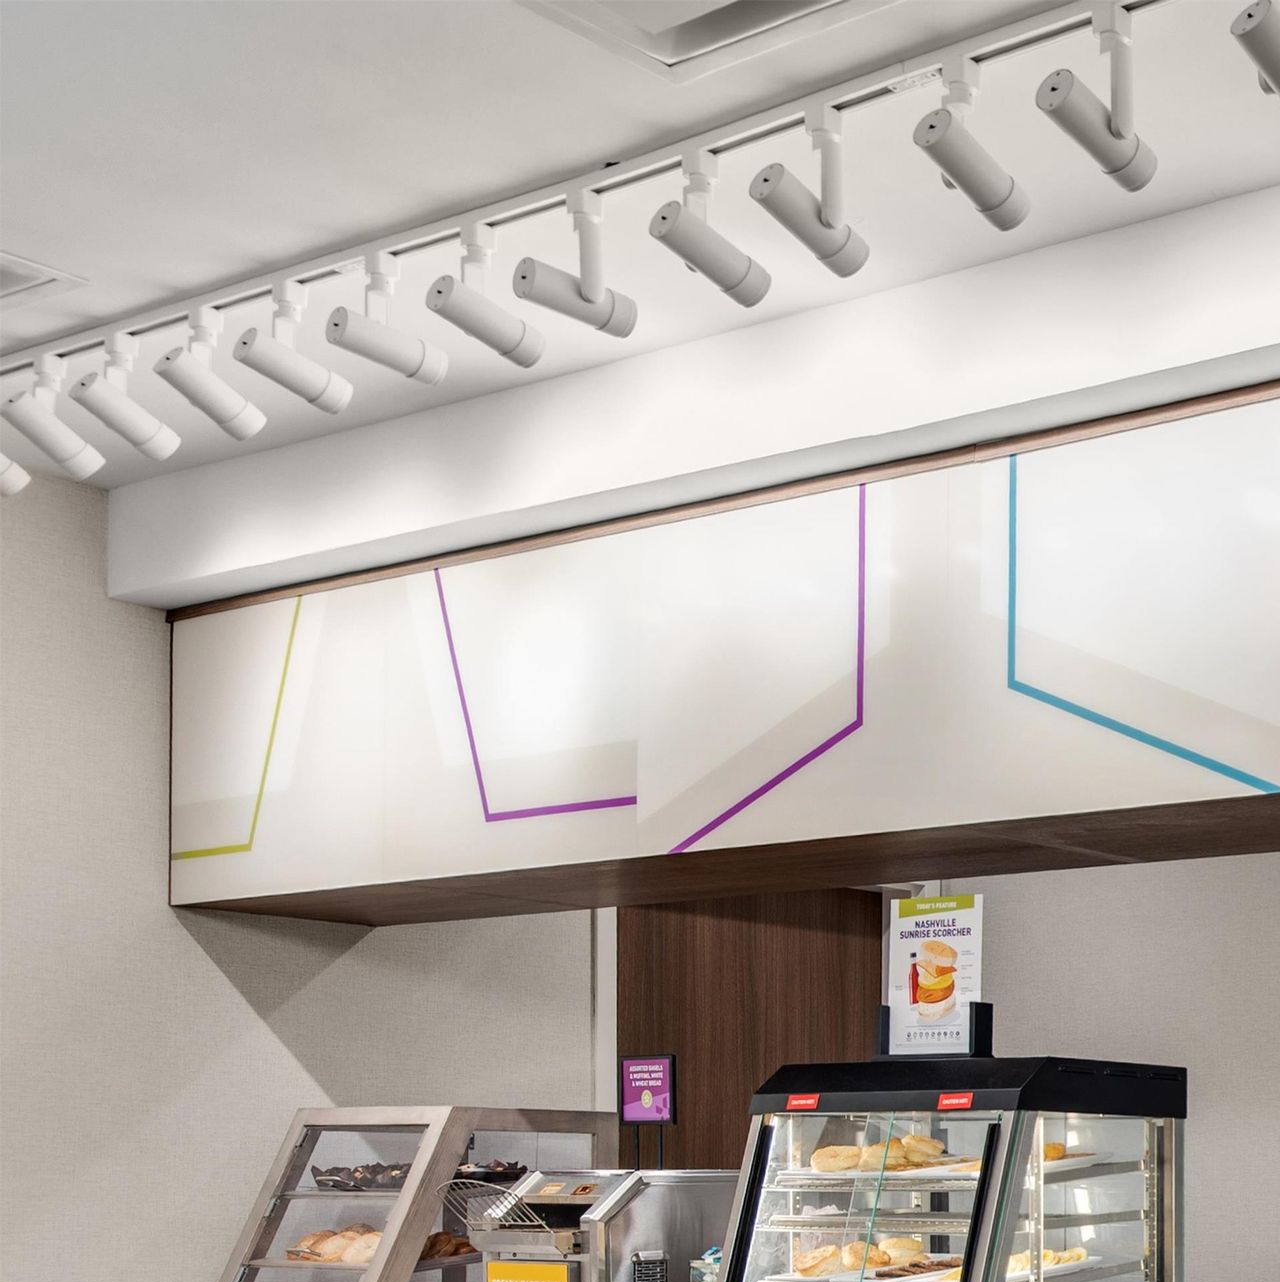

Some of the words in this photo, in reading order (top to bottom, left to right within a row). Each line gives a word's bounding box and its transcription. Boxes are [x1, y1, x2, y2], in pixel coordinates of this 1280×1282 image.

[915, 919, 956, 928] NASHVILLE
[900, 930, 931, 939] SUNRISE
[933, 928, 971, 937] SCORCHER
